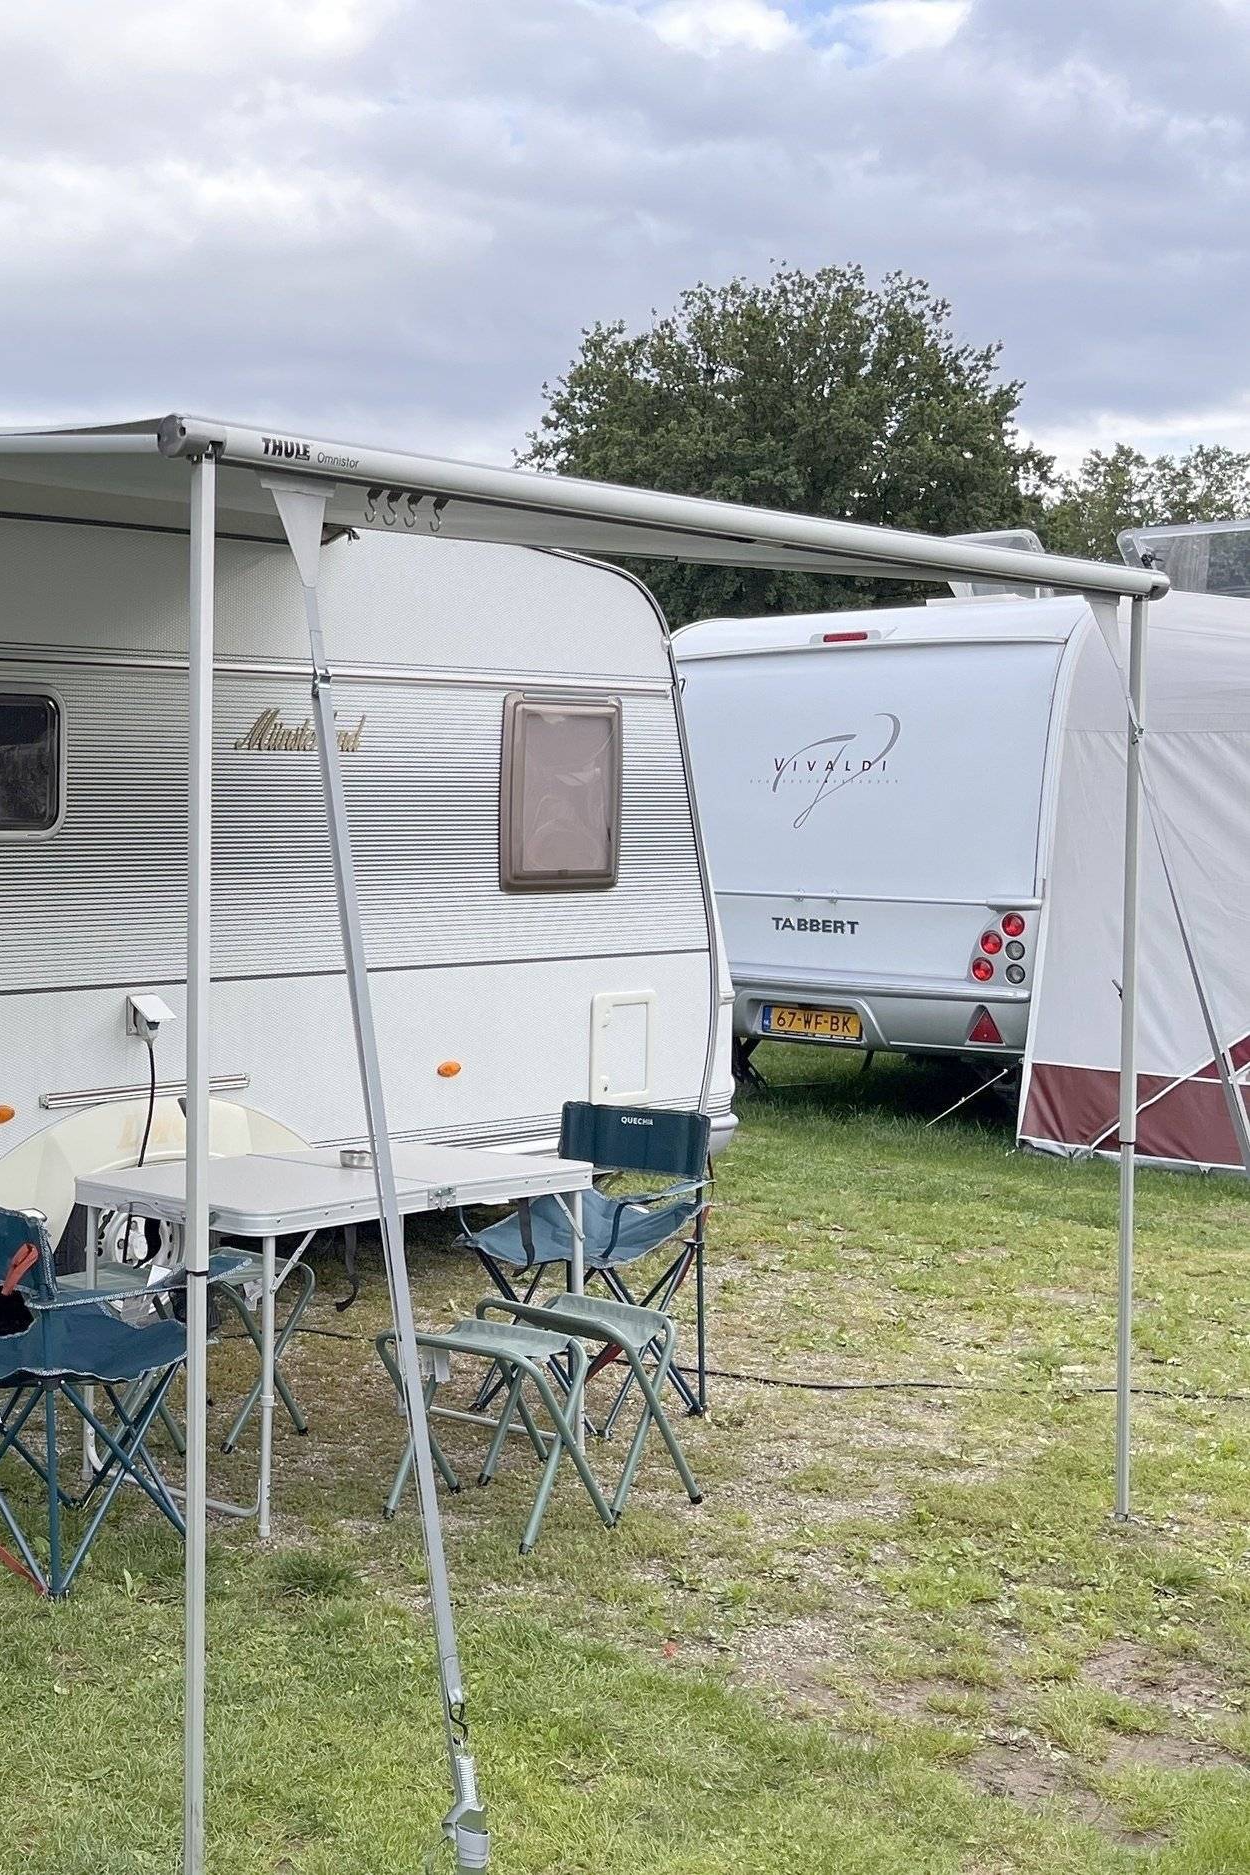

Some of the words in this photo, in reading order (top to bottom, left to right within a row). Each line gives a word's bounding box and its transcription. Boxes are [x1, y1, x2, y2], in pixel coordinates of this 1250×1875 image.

[261, 437, 310, 461] THULE
[317, 452, 360, 469] Omnistor
[774, 758, 887, 772] VIVALDI
[771, 917, 860, 935] TABBERT
[776, 1011, 852, 1033] 67-WF-BK
